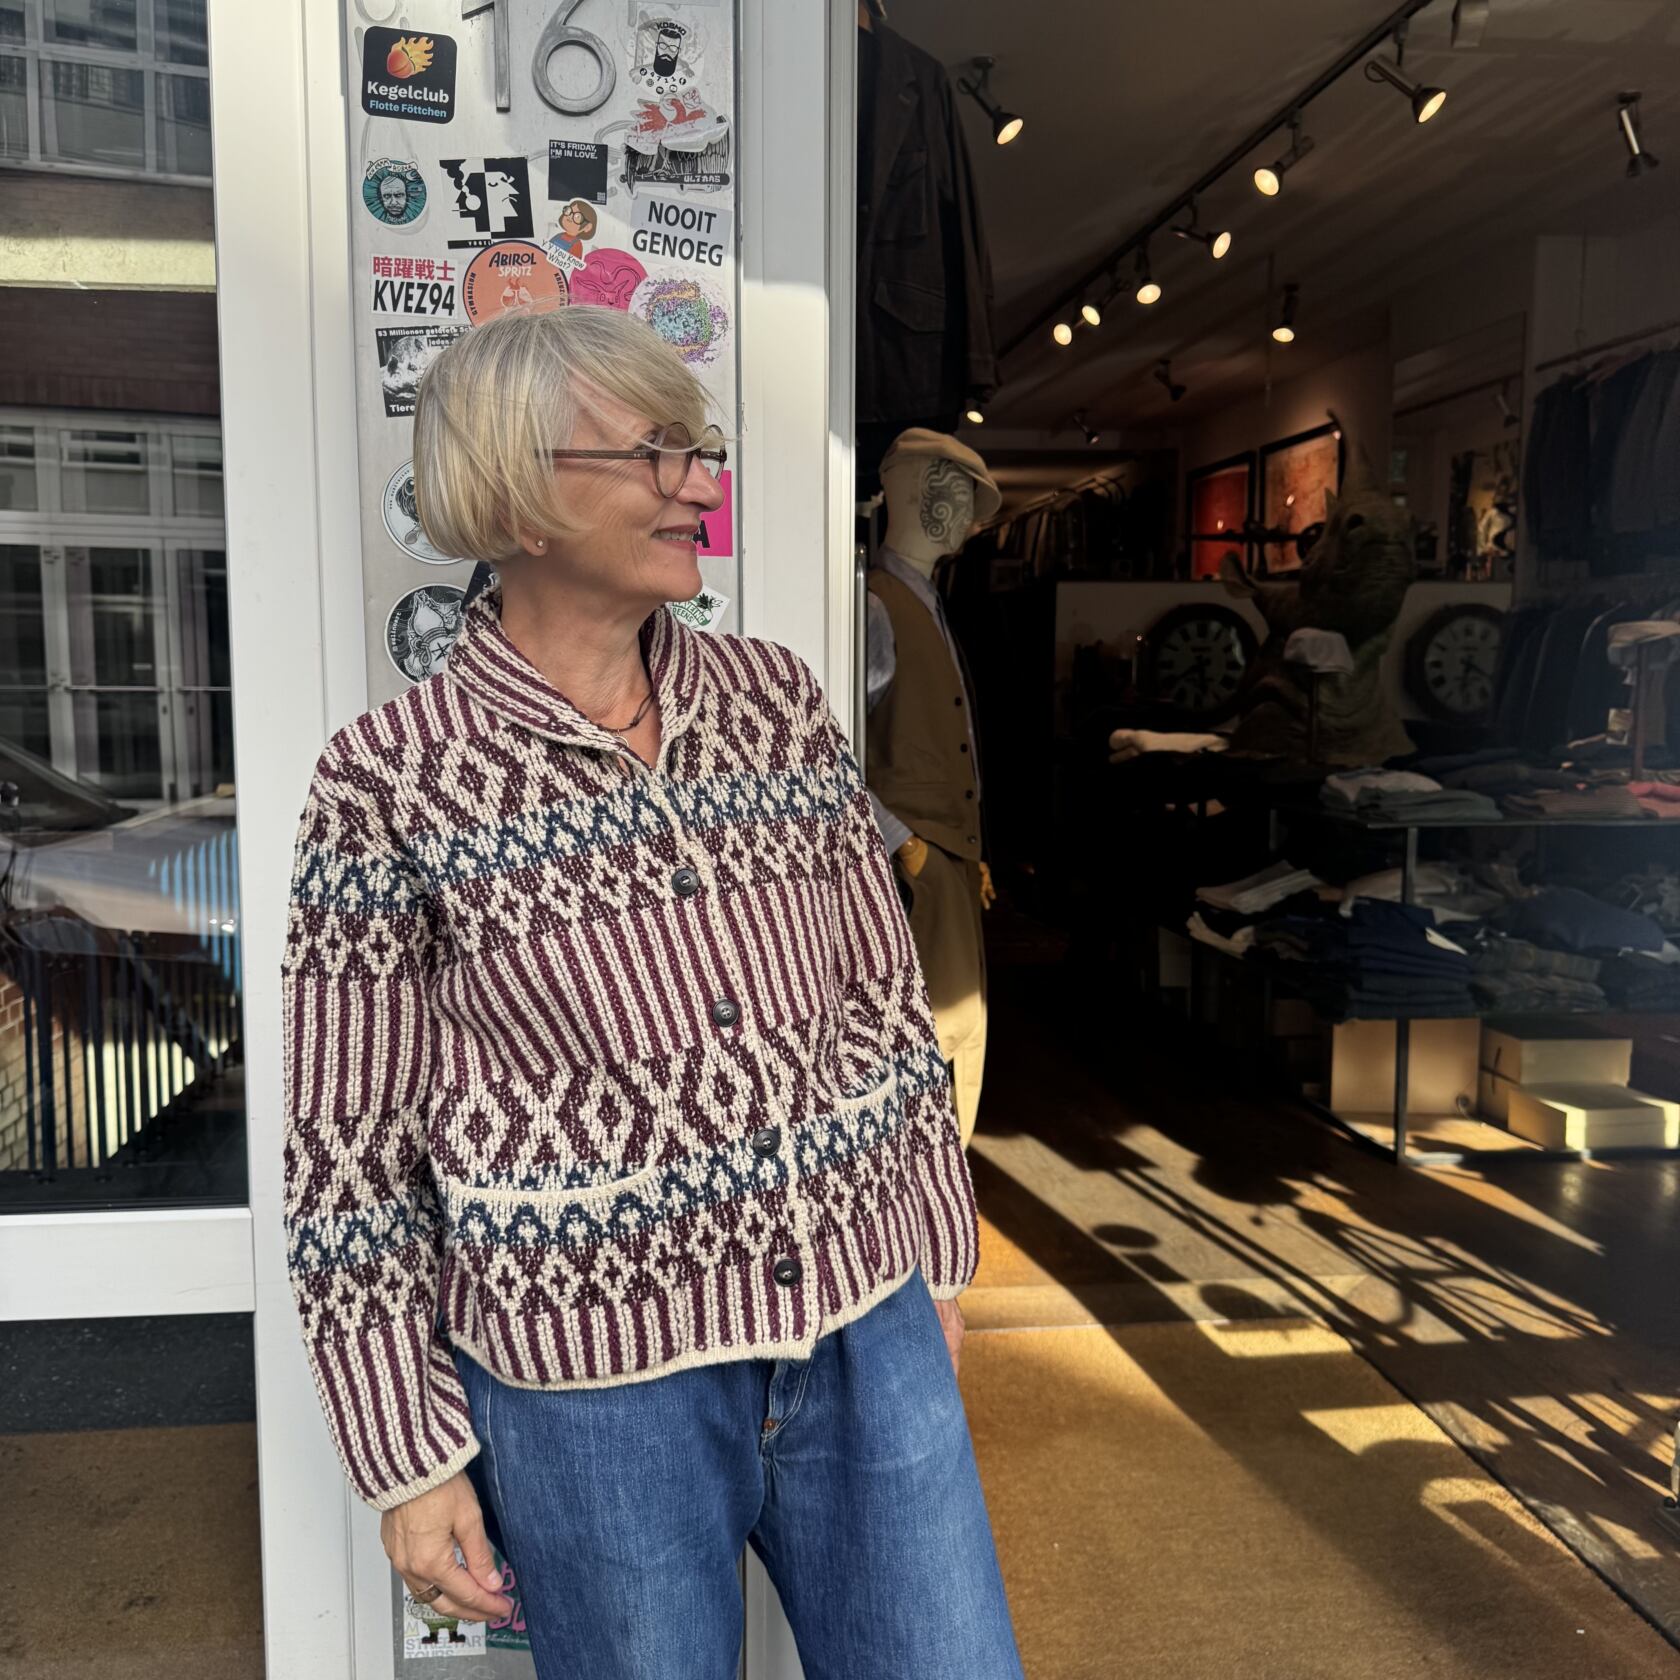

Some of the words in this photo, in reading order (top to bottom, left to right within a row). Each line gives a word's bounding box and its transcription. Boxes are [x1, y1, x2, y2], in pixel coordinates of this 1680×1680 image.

[367, 81, 449, 104] Kegelclub
[369, 100, 400, 112] Flotte
[401, 103, 447, 118] Föttchen
[550, 141, 566, 149] IT'S
[567, 143, 597, 153] FRIDAY,
[648, 200, 717, 234] NOOIT
[554, 246, 567, 259] You
[567, 255, 585, 269] Know
[632, 229, 723, 267] GENOEG
[489, 251, 537, 268] ABIROL
[548, 253, 571, 269] What?
[373, 280, 455, 316] KVEZ94
[389, 328, 424, 336] Millionen
